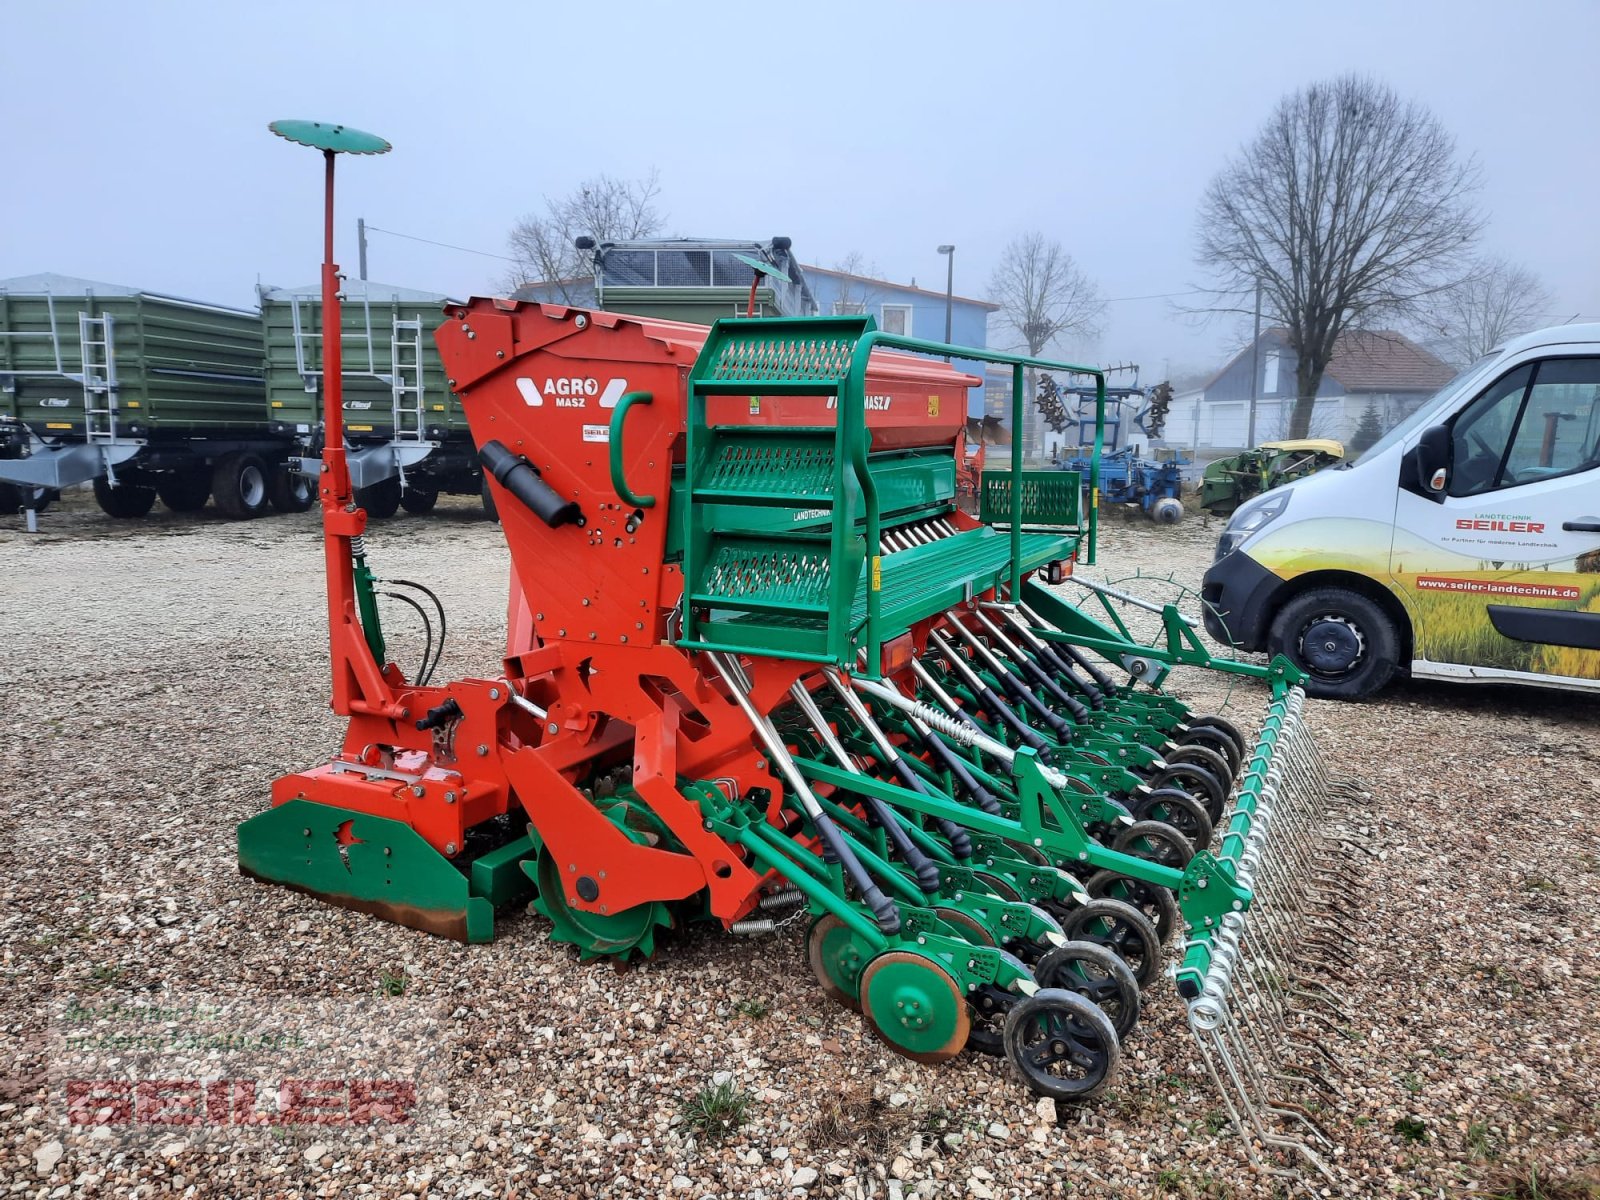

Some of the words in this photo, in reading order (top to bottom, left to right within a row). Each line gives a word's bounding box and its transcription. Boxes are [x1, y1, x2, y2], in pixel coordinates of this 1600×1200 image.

[543, 377, 599, 397] AGRO
[555, 397, 586, 408] MASZ
[1456, 519, 1545, 534] SEILER
[1418, 579, 1578, 598] www.seiler-landtechnik.de
